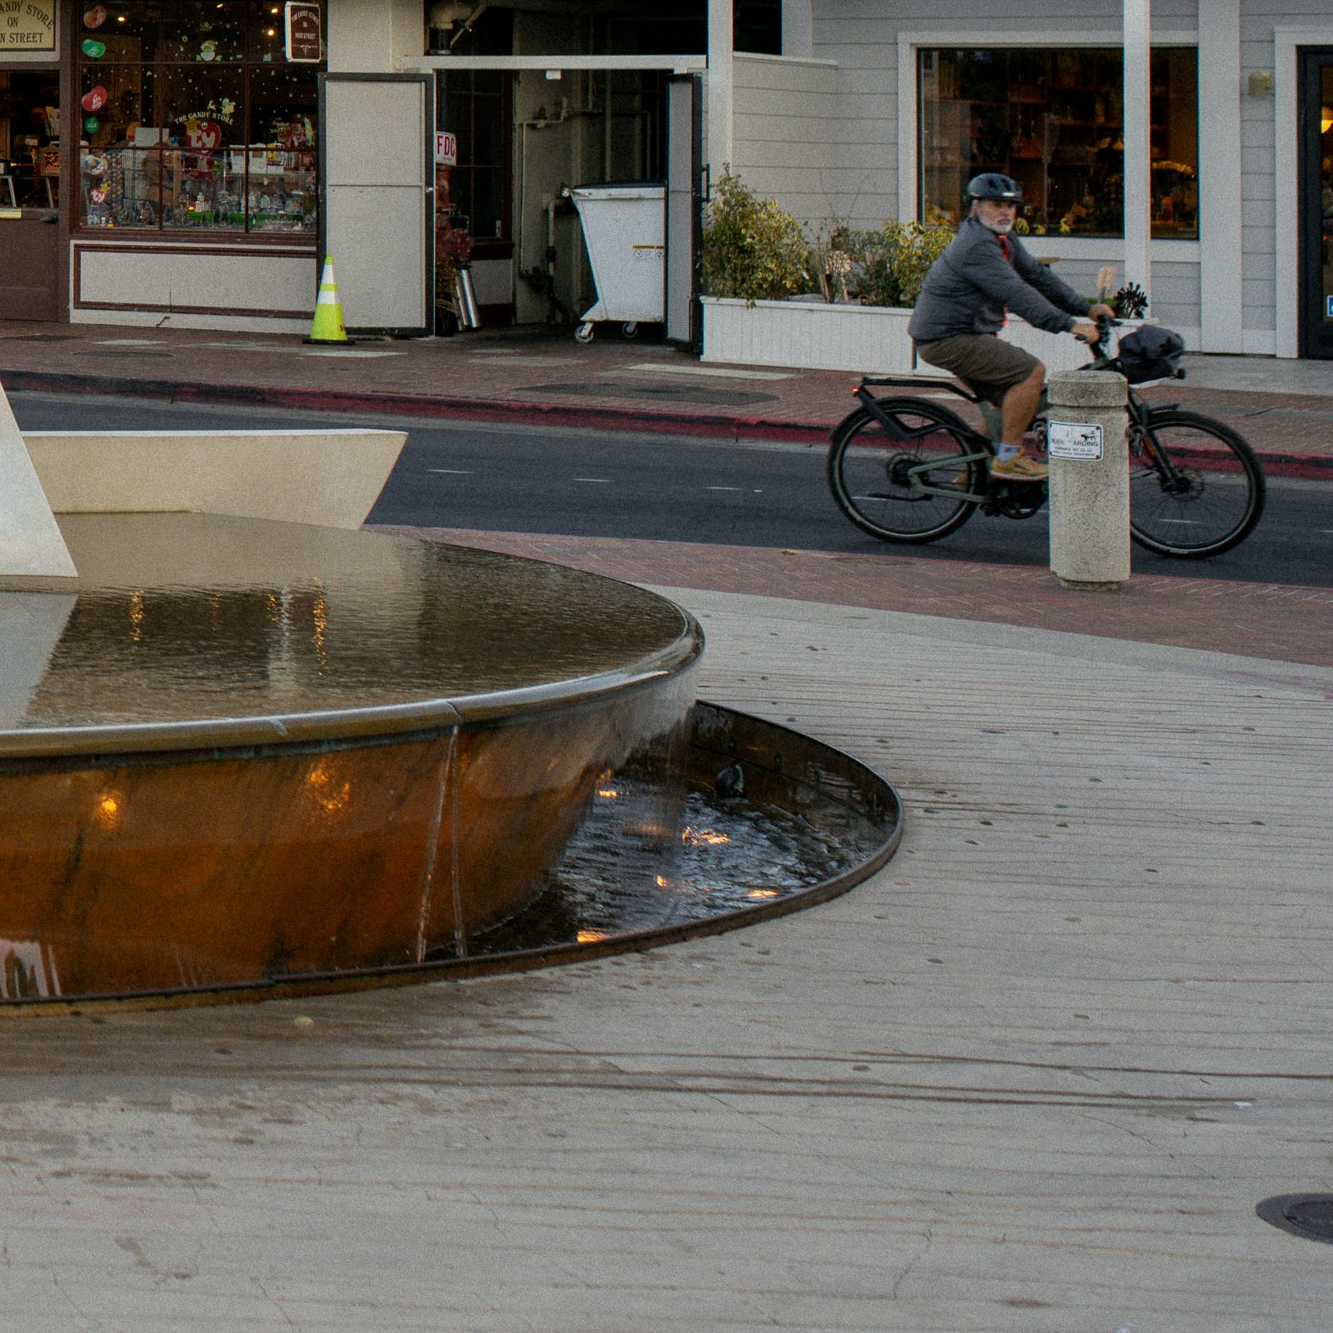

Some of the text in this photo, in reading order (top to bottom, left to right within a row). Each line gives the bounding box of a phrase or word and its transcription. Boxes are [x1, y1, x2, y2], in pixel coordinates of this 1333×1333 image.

[7, 16, 19, 27] ON
[26, 4, 54, 31] STORE
[9, 32, 44, 43] STREET
[187, 110, 211, 119] CANDY
[212, 112, 234, 125] STORE
[187, 129, 216, 154] ty
[436, 135, 455, 157] FDC
